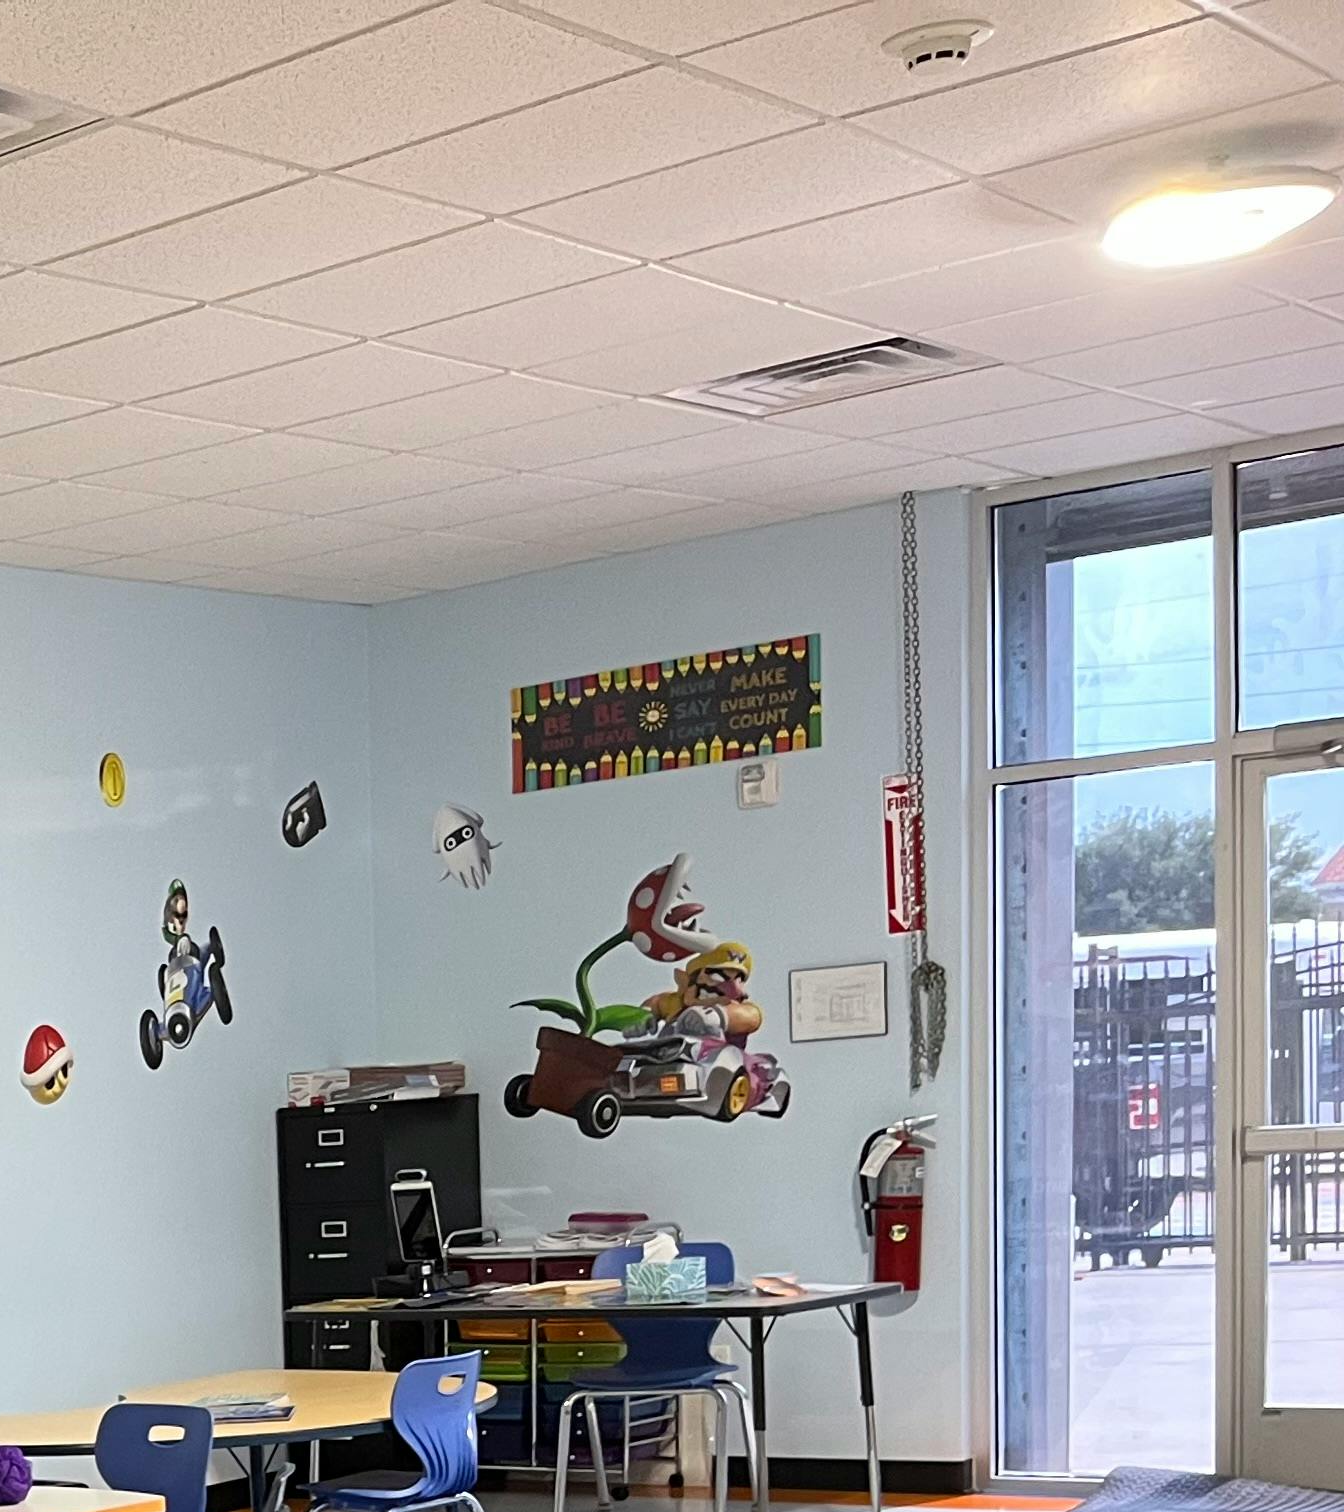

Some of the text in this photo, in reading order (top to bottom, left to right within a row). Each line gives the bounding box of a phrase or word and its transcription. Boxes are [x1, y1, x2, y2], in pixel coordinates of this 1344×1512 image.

[671, 679, 716, 697] NEVER
[730, 667, 787, 692] MAKE
[674, 698, 712, 720] SAY
[720, 688, 798, 713] EVERY DAY
[594, 700, 626, 726] BE
[729, 708, 788, 729] COUNT
[544, 713, 571, 736] BE
[584, 727, 638, 748] BRAVE
[887, 795, 916, 811] FIRE
